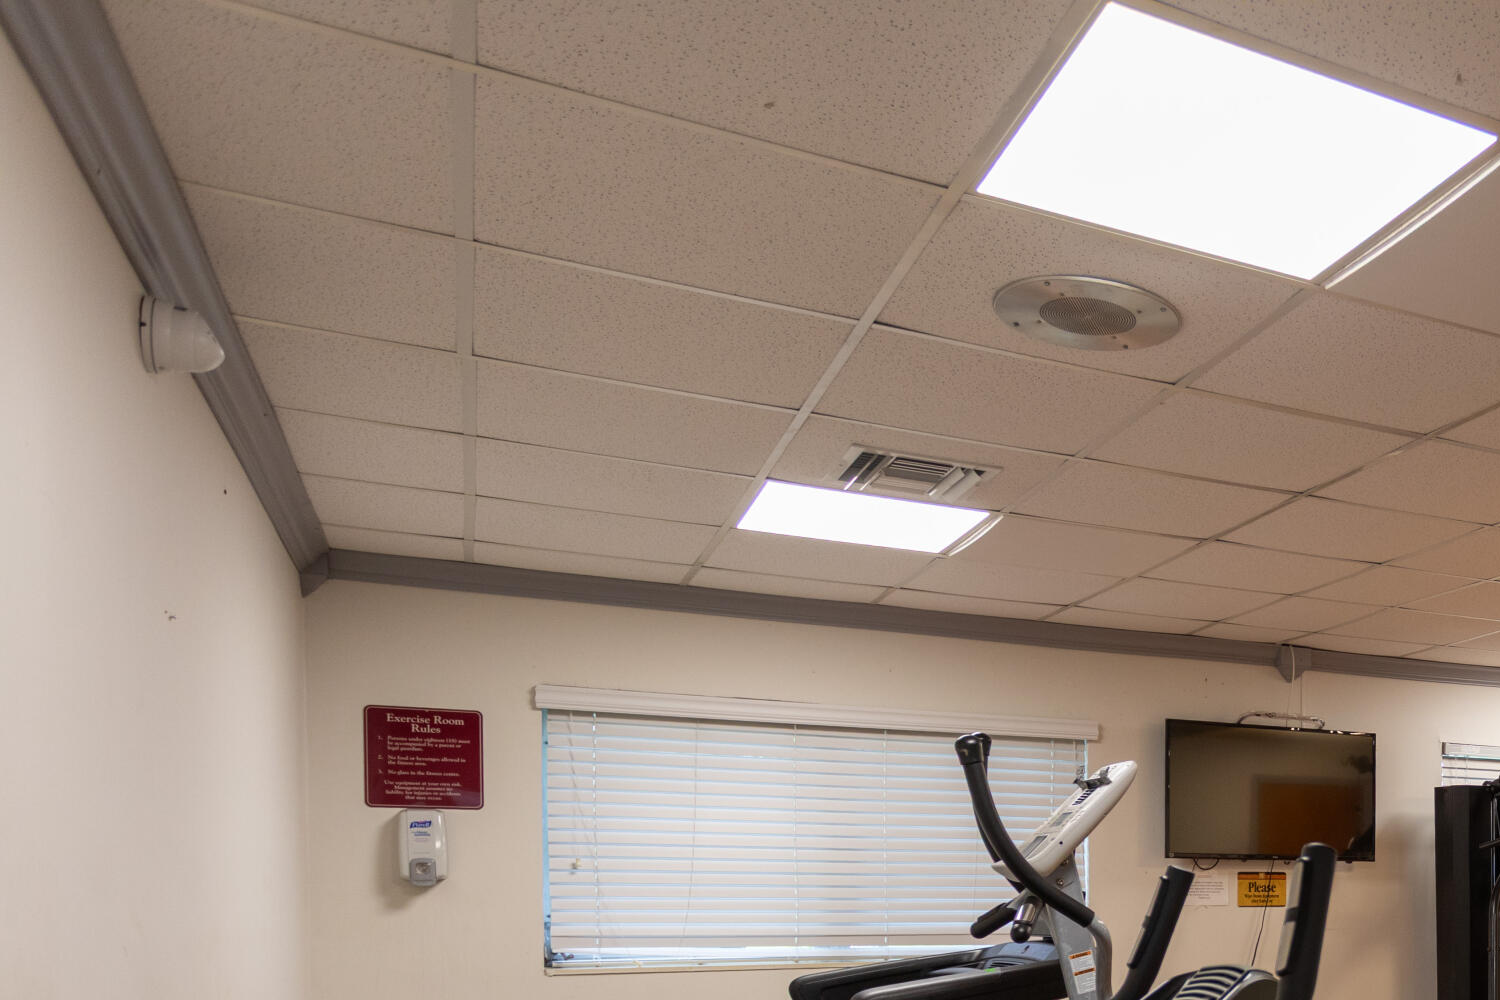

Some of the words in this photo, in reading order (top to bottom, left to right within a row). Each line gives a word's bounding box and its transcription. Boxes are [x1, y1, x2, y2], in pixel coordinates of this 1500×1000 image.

[386, 712, 430, 724] Exercise
[433, 715, 465, 726] Room
[411, 723, 441, 734] Rules
[1248, 881, 1277, 893] Please
